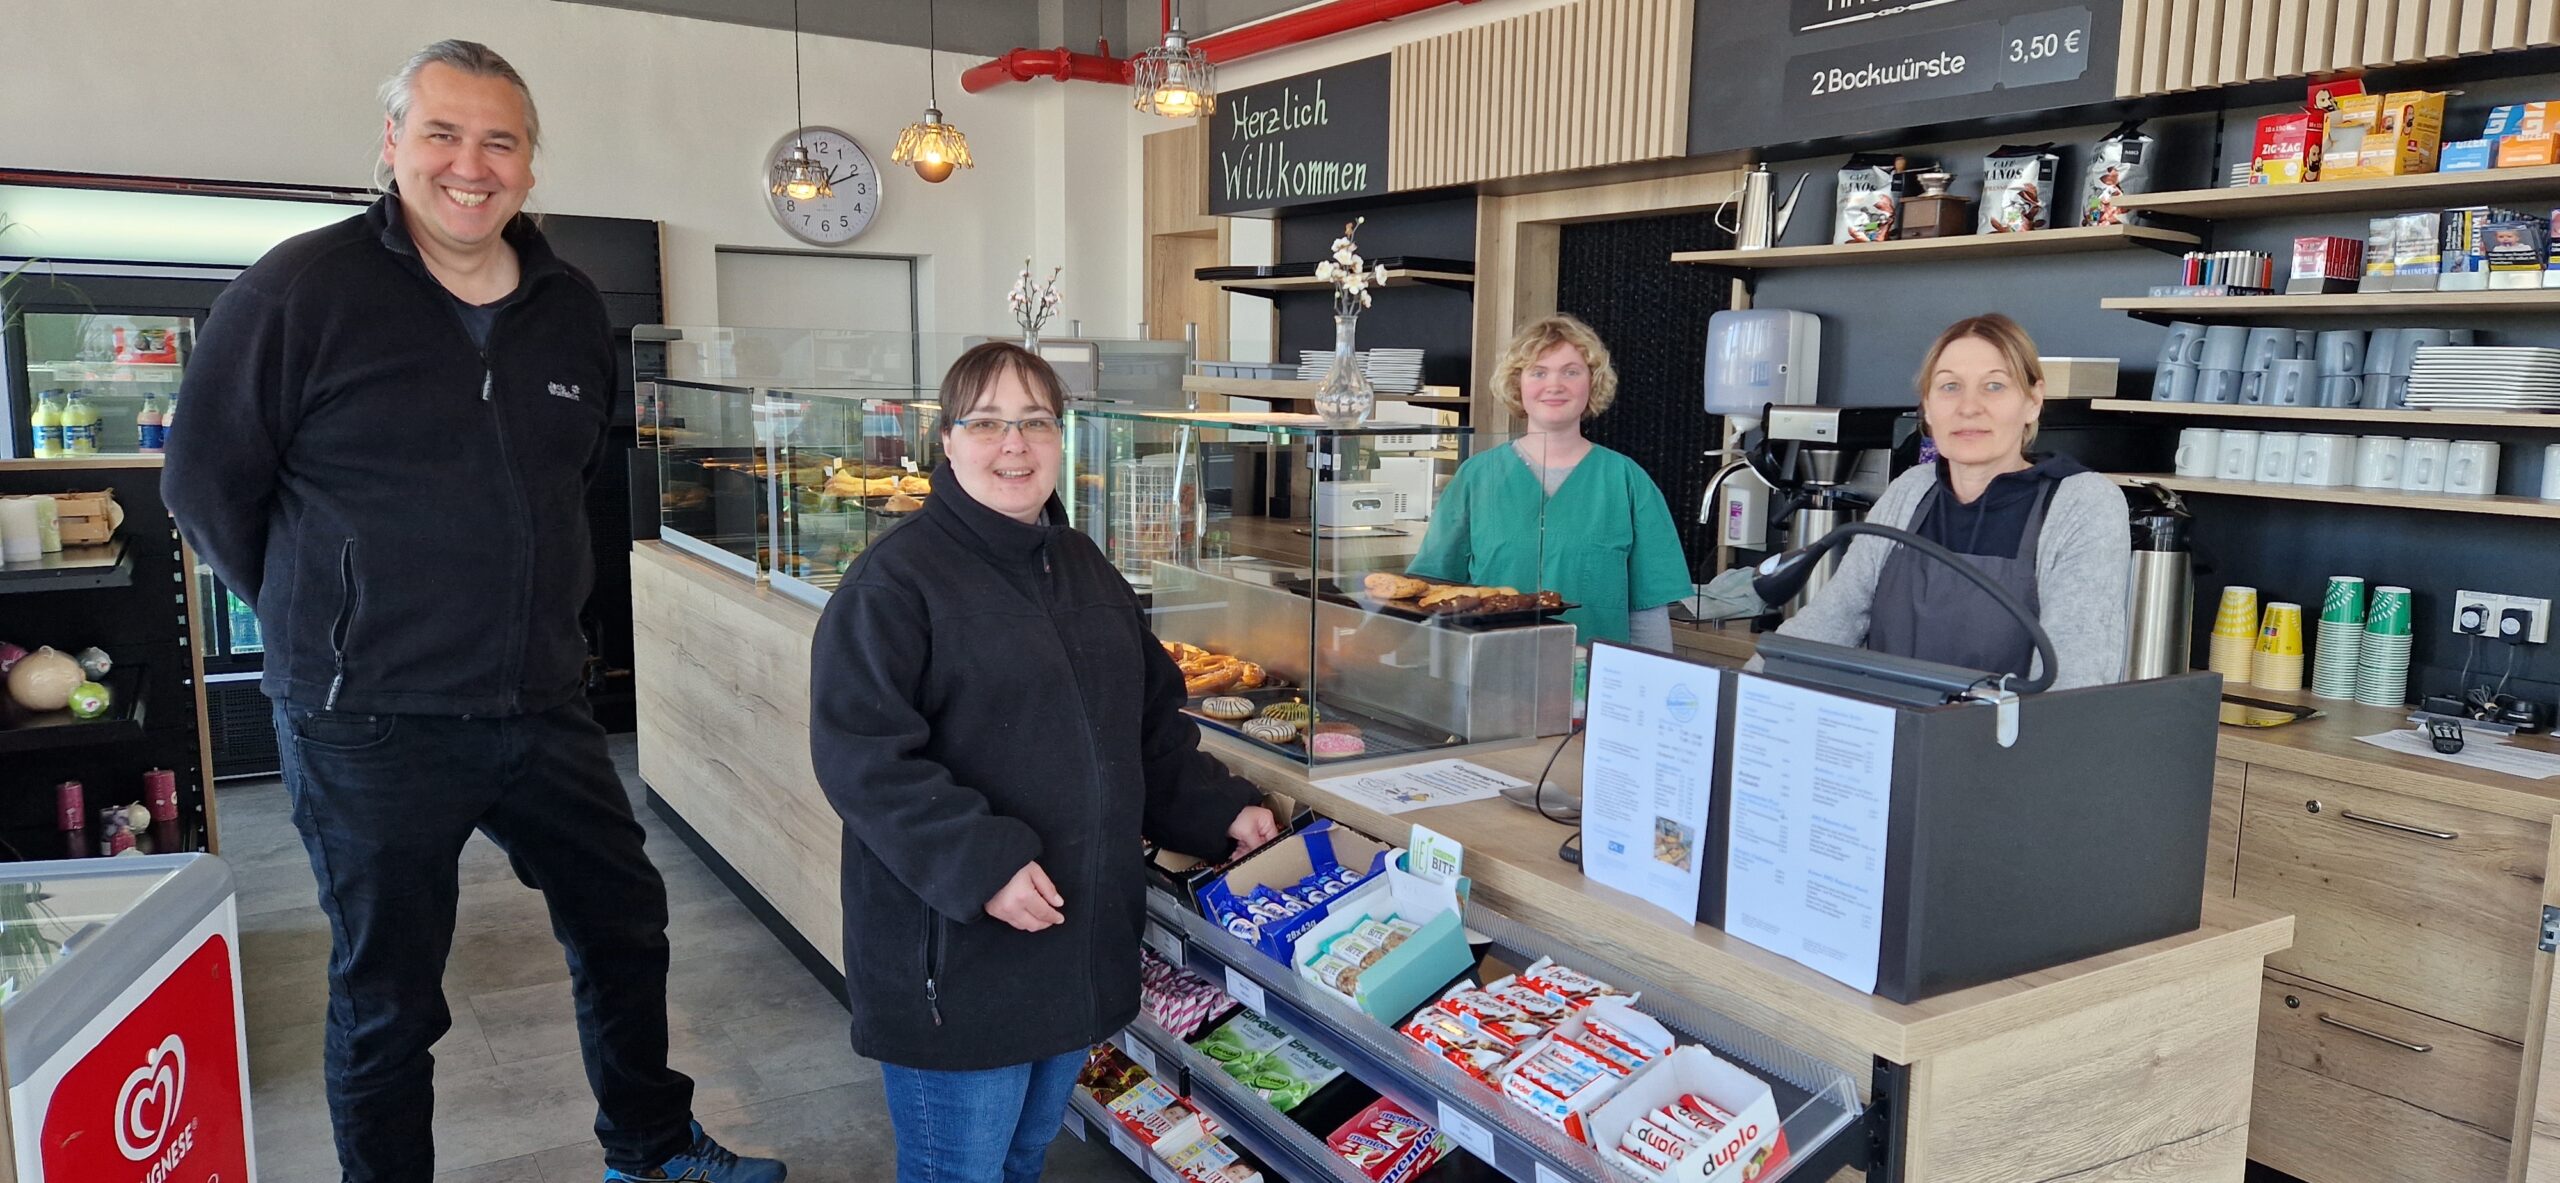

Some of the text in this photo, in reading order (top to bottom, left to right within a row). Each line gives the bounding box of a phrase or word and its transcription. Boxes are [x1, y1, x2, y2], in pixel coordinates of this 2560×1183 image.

[1811, 29, 2082, 96] 2 Bockwürste 3,50 €
[1231, 78, 1329, 142] Herzlich
[813, 141, 828, 154] 12
[837, 149, 842, 160] 1
[2262, 142, 2302, 155] ZIG-ZAG
[850, 164, 858, 175] 2
[1222, 140, 1368, 201] Willkommen
[857, 183, 866, 195] 3
[786, 200, 795, 212] 8
[853, 203, 862, 213] 4
[803, 215, 811, 226] 7
[821, 220, 830, 232] 6
[840, 216, 848, 227] 5
[2472, 214, 2481, 256] DRUM
[1432, 857, 1455, 875] BITE
[1548, 970, 1593, 987] bueno
[1512, 988, 1558, 1008] bueno
[1288, 1038, 1338, 1071] Em-eukal
[1381, 1111, 1422, 1128] mentos
[1348, 1134, 1390, 1151] mentos
[1703, 1124, 1758, 1176] duplo
